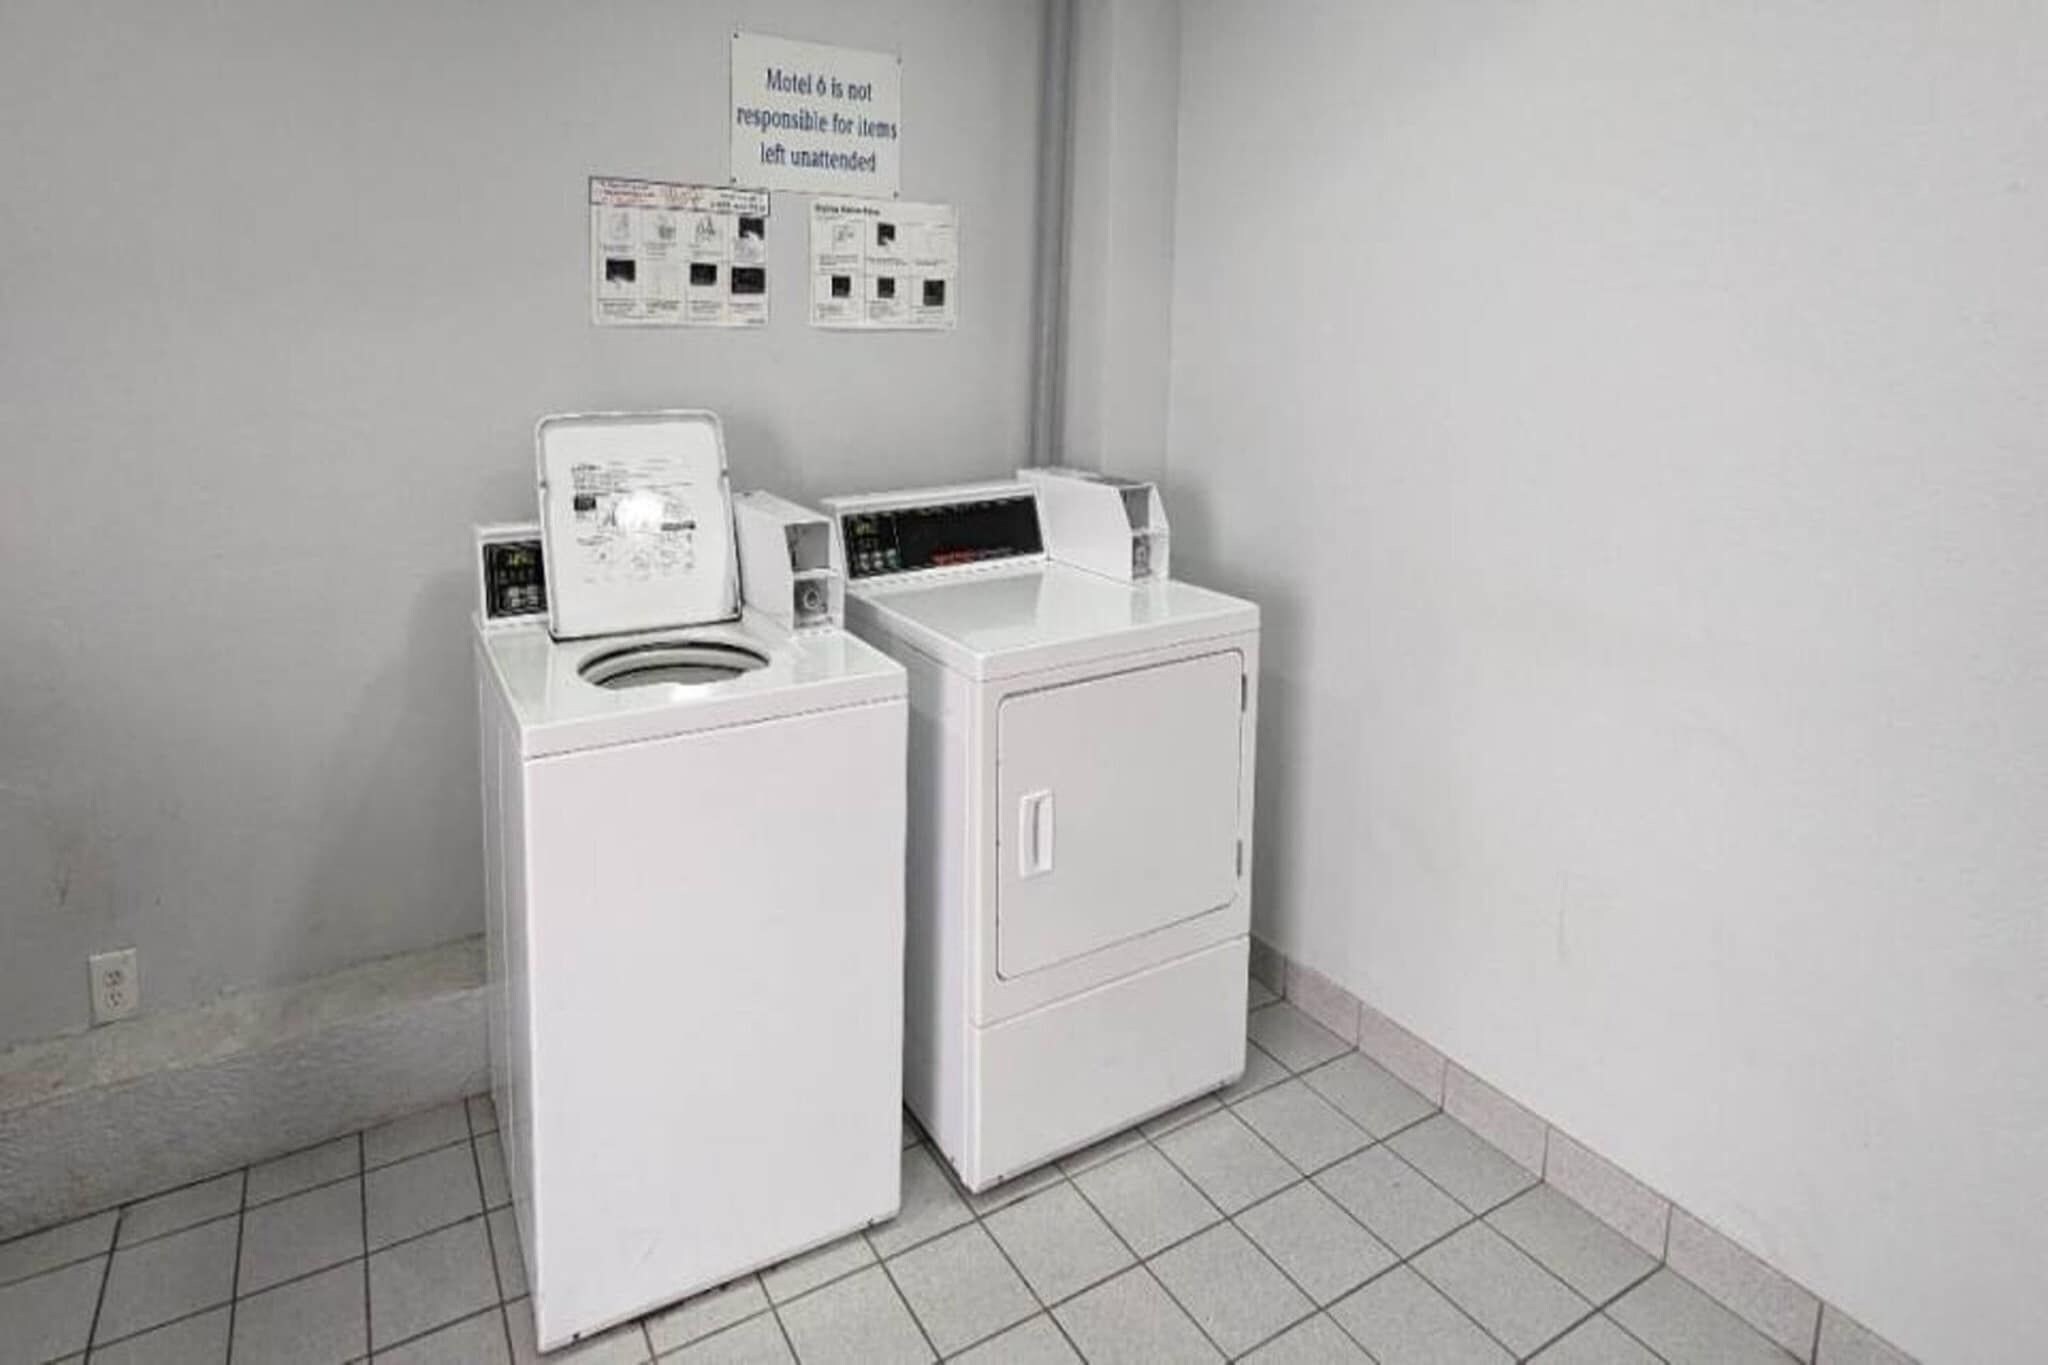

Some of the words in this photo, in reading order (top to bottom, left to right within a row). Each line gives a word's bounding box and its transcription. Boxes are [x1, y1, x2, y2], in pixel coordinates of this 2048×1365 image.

[767, 68, 811, 94] Motel
[816, 77, 826, 96] 6
[831, 77, 843, 99] is
[848, 82, 872, 102] not
[737, 107, 827, 133] responsible
[833, 113, 854, 134] for
[857, 116, 897, 140] items
[761, 142, 785, 165] left
[791, 148, 876, 172] unattended
